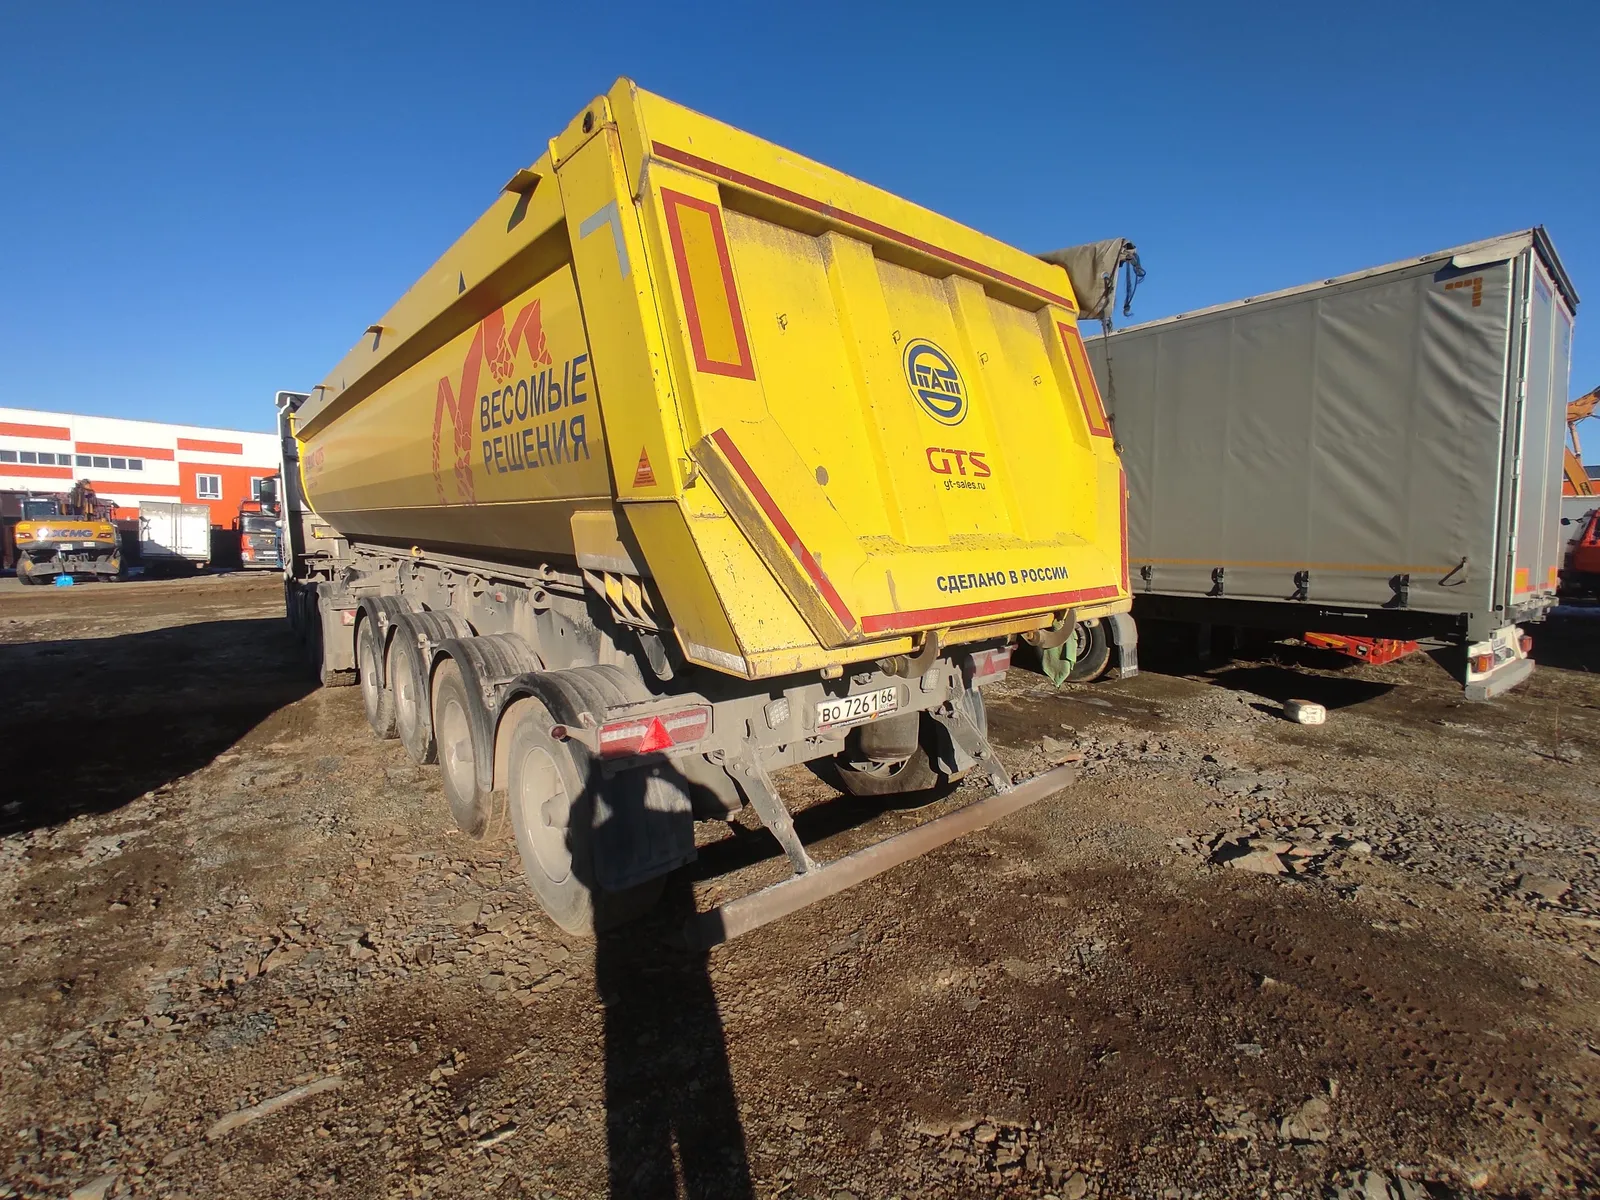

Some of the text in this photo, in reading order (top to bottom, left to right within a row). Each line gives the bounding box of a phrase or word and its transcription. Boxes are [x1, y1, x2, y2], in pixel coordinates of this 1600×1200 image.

[480, 353, 588, 432] ВЕСОМЫЕ
[482, 414, 590, 475] РЕШЕНИЯ
[926, 447, 991, 477] GTS
[51, 529, 93, 538] XCMG
[936, 566, 1069, 593] СДЕЛАНО В РОССИИ
[822, 706, 841, 722] ВО
[845, 694, 877, 718] 7261
[881, 689, 893, 704] 66
